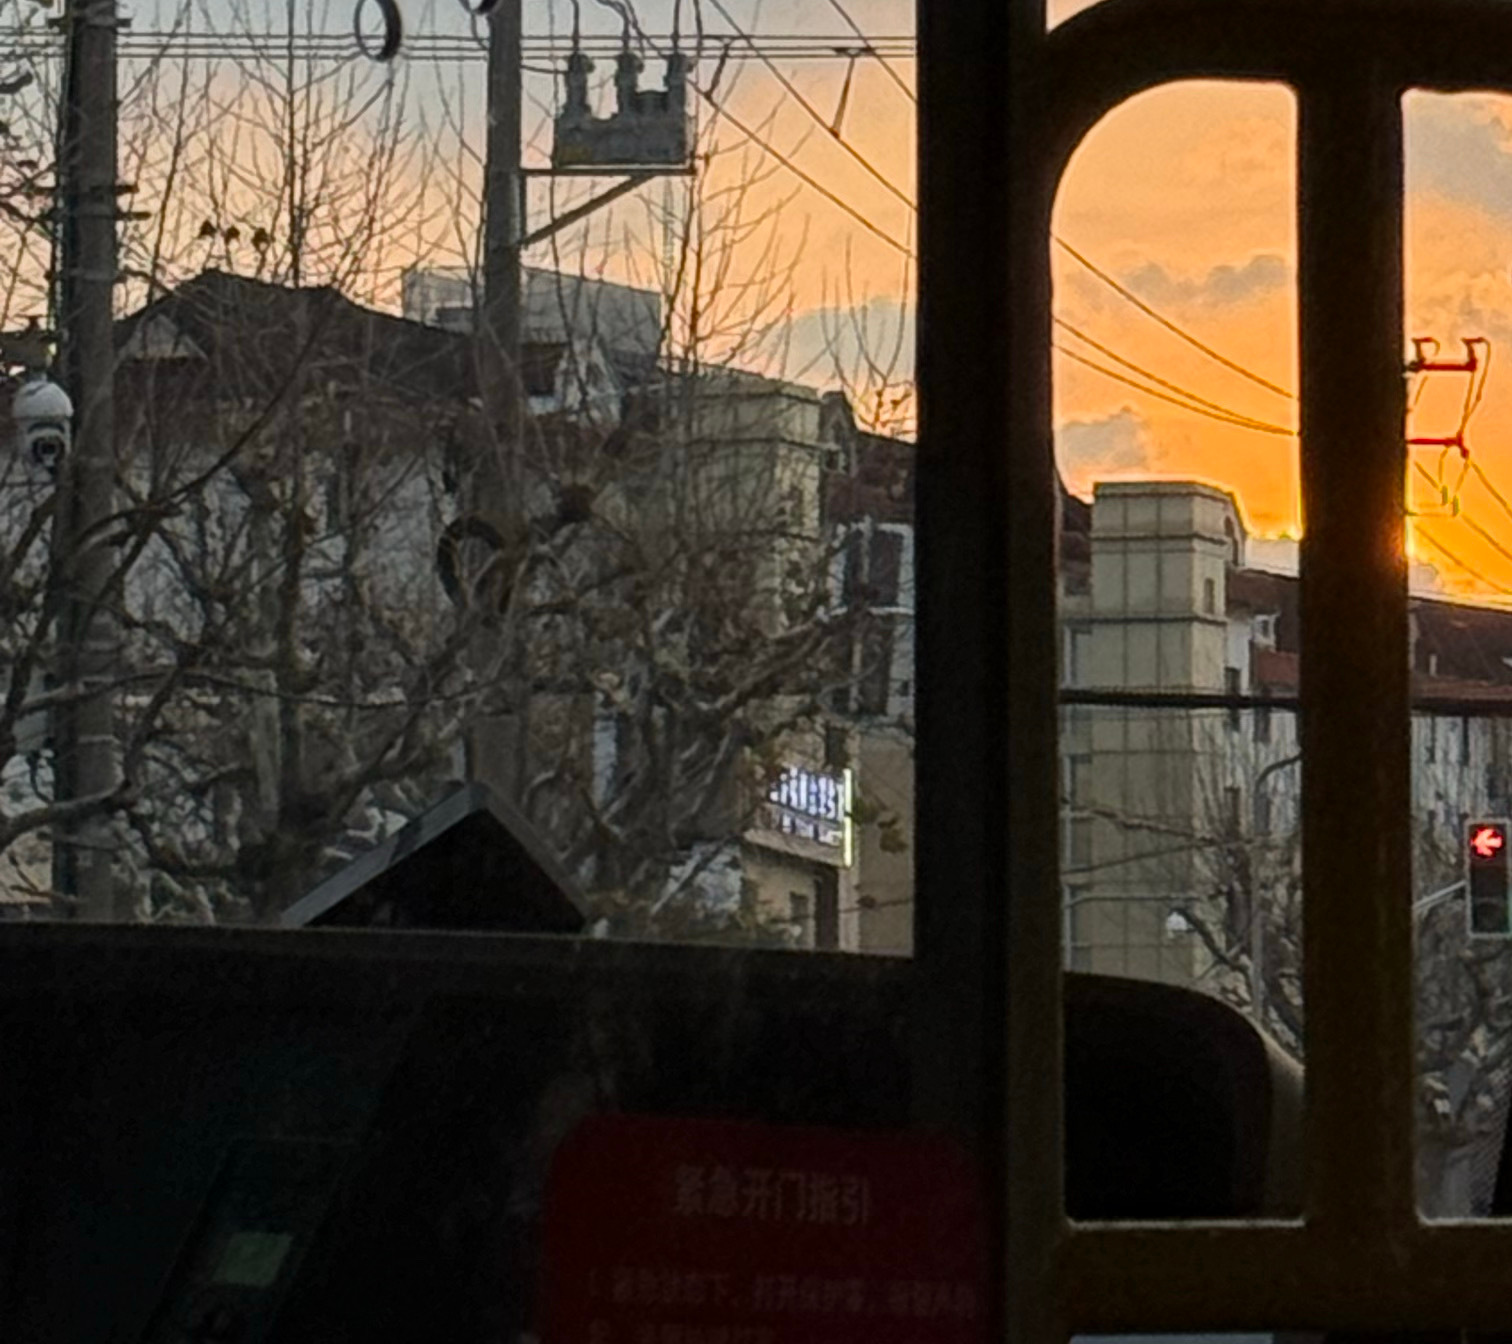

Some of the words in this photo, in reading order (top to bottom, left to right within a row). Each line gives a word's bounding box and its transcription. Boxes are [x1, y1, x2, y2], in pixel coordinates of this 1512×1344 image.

[672, 1165, 871, 1226] 紧急开门指引
